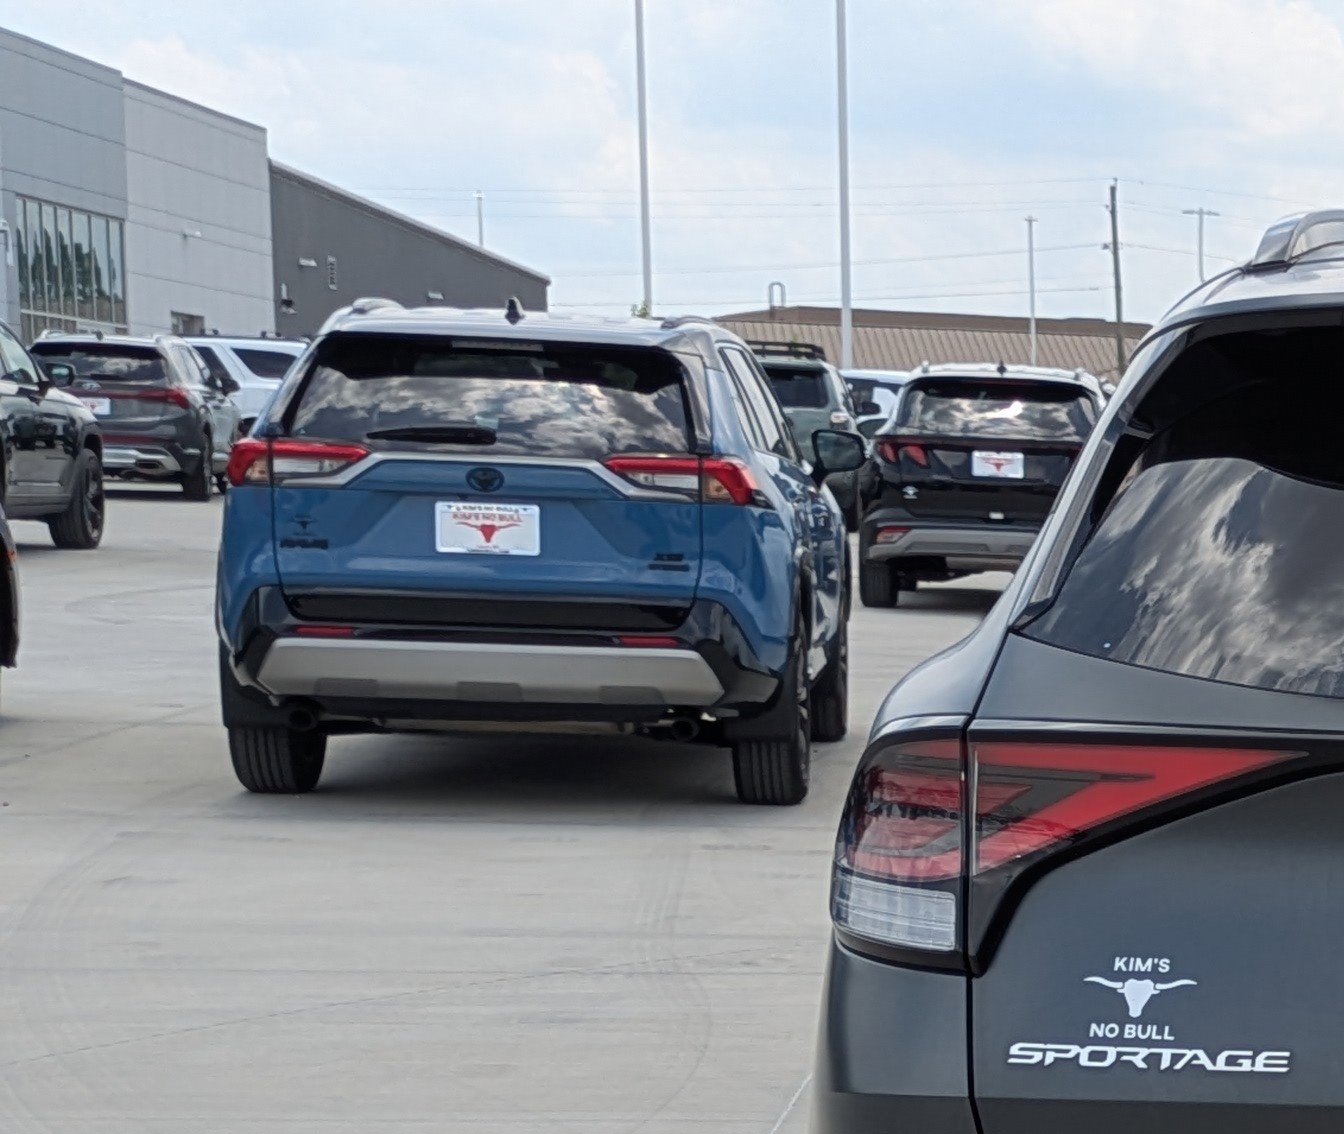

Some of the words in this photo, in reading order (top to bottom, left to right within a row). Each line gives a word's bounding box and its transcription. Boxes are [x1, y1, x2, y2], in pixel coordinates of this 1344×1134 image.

[1113, 956, 1171, 973] KIM'S
[1089, 1022, 1120, 1038] NO
[1123, 1024, 1175, 1040] BULL
[1007, 1042, 1291, 1073] SPORTAGE
